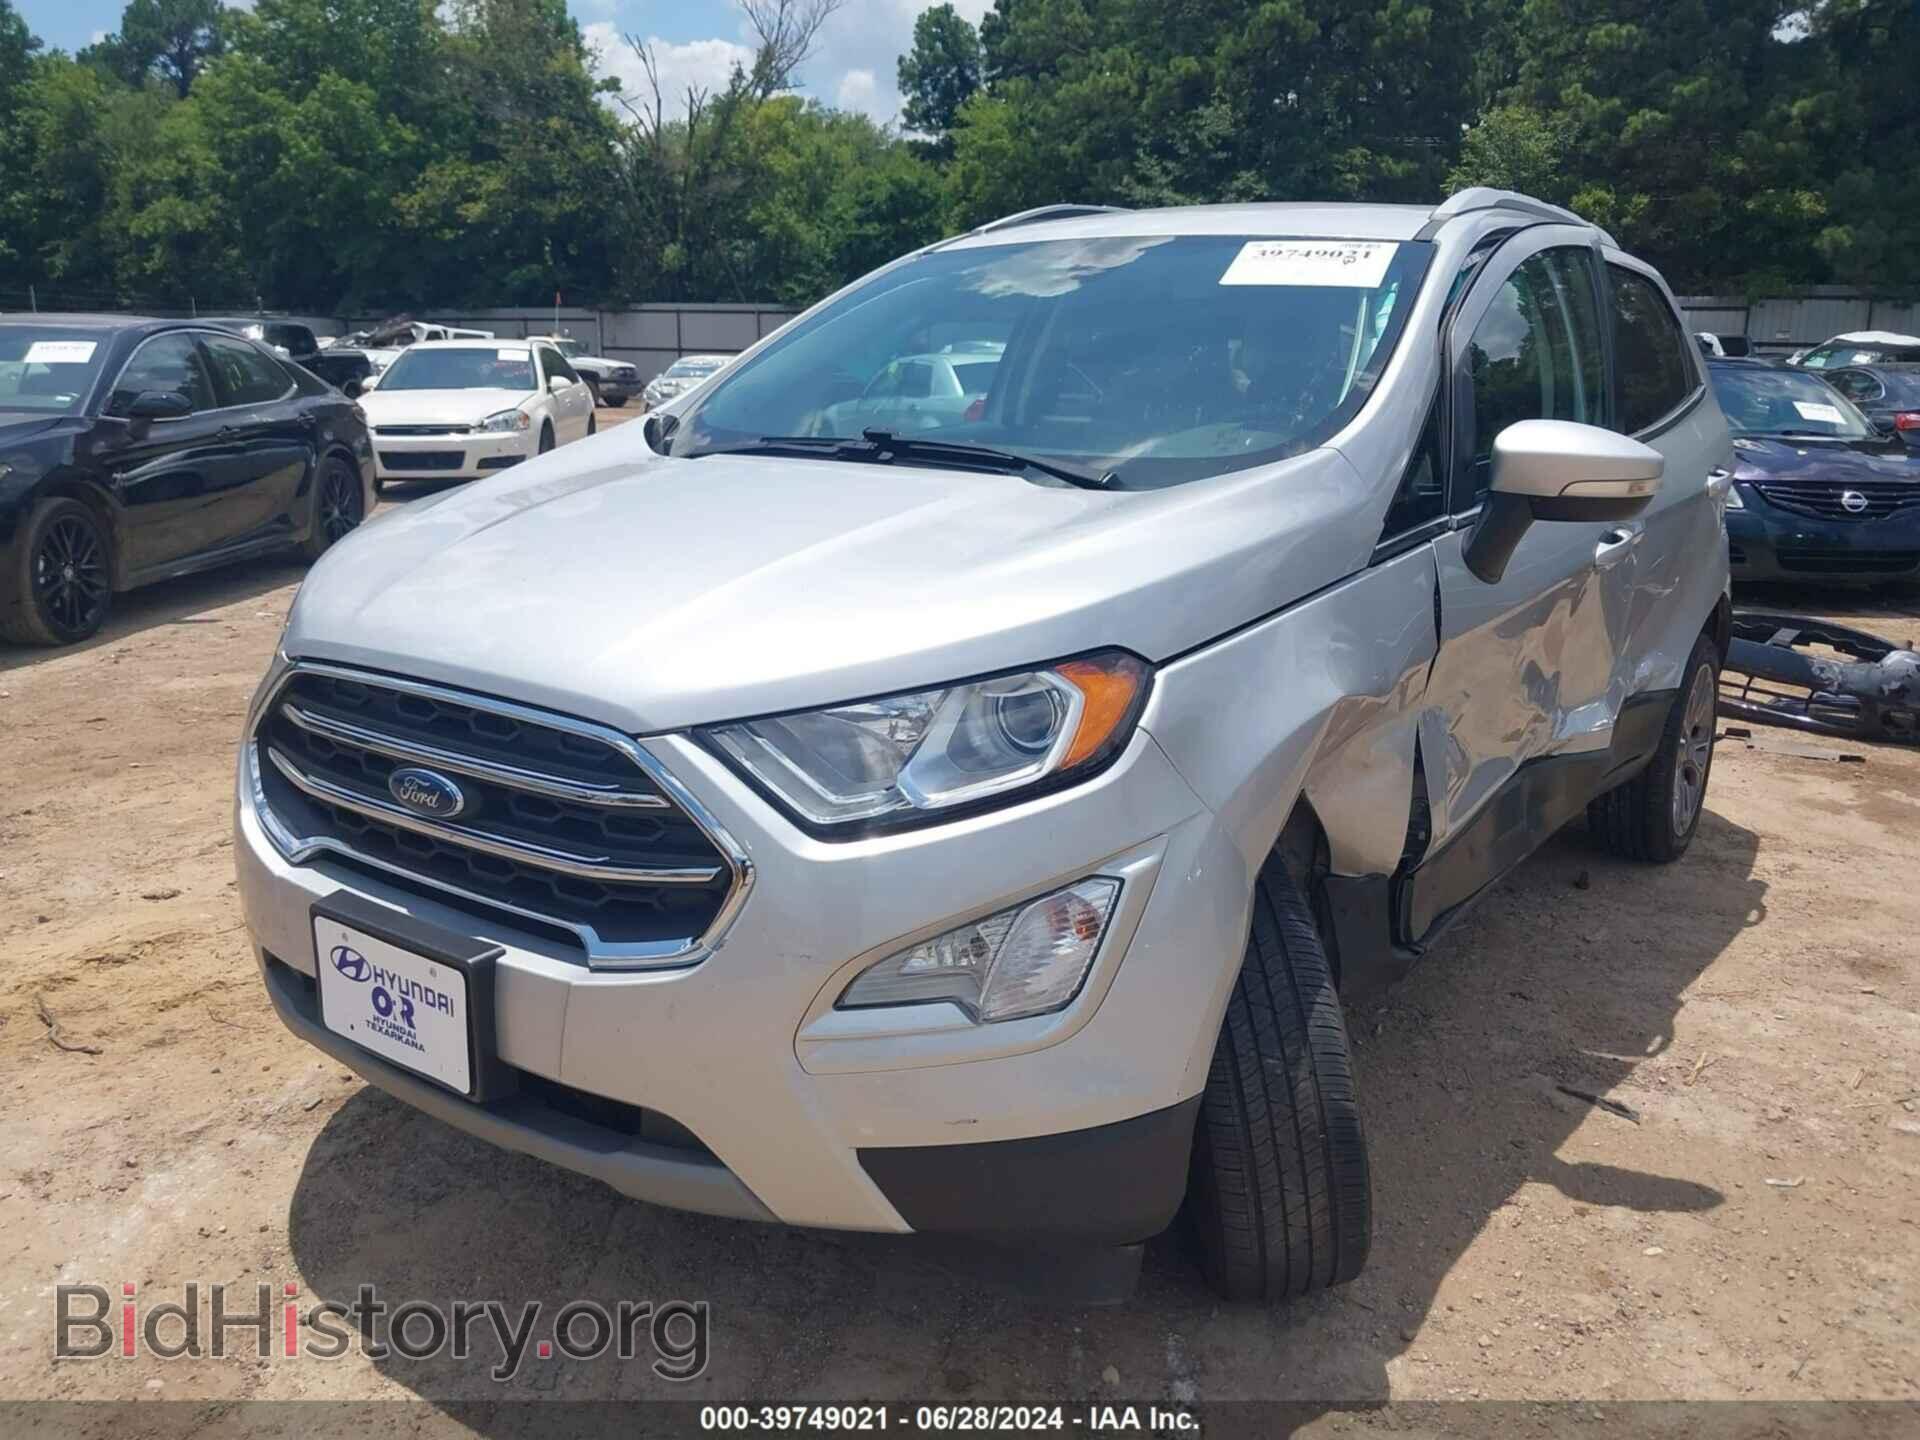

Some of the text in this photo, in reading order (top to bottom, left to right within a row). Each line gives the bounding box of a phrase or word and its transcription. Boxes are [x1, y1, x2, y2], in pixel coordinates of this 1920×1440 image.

[399, 775, 441, 809] Ford
[373, 965, 455, 1017] HYUNDAI
[365, 1019, 425, 1053] TEXARKANA
[372, 1015, 417, 1040] HYUNDAI
